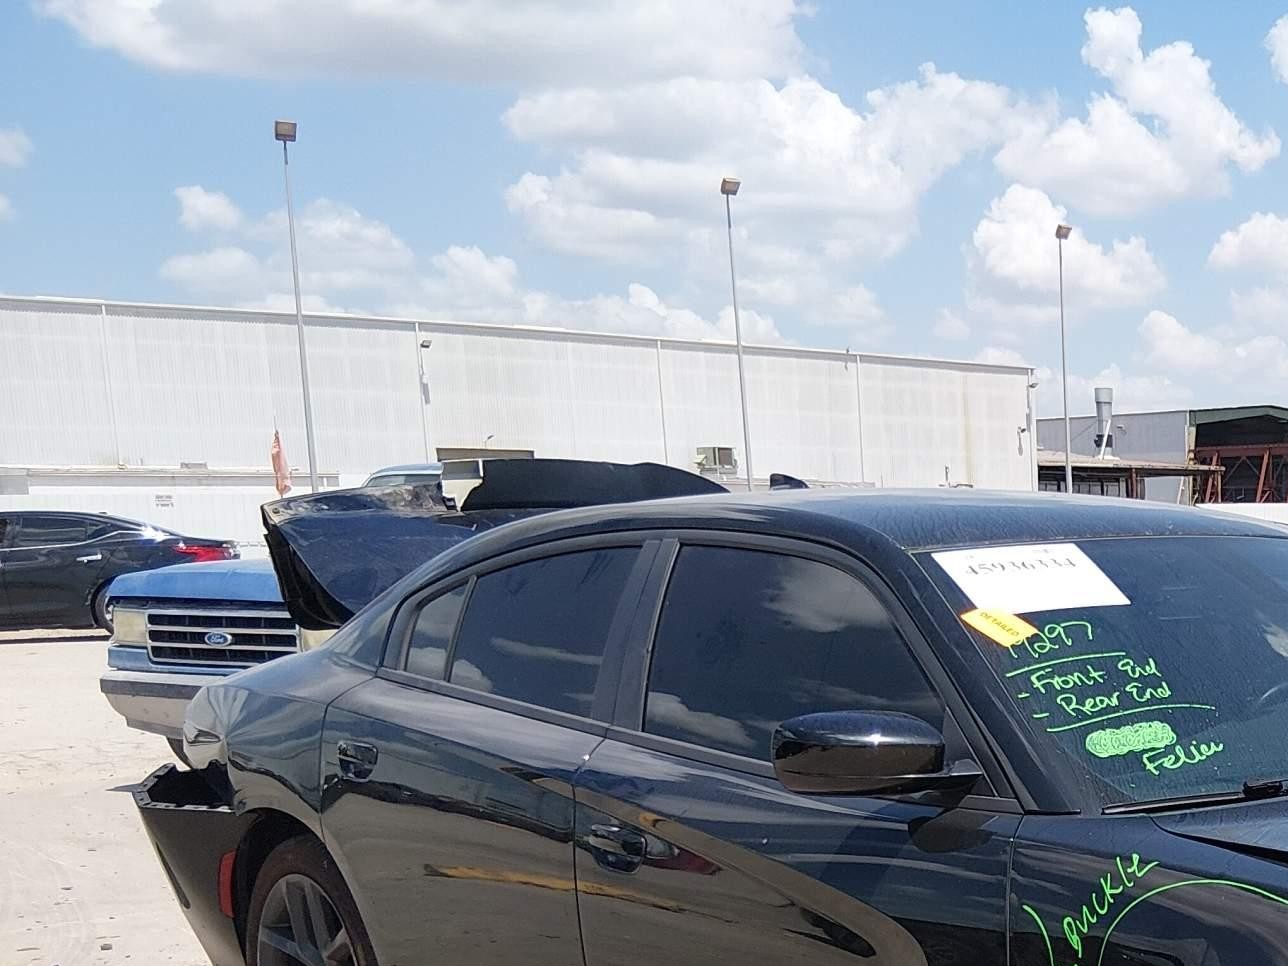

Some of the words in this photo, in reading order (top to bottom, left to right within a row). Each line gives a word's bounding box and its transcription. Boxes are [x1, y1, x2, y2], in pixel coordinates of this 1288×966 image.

[965, 557, 1076, 576] 45936334
[1030, 665, 1105, 694] Front
[1056, 691, 1120, 716] Rear
[1125, 681, 1172, 703] End
